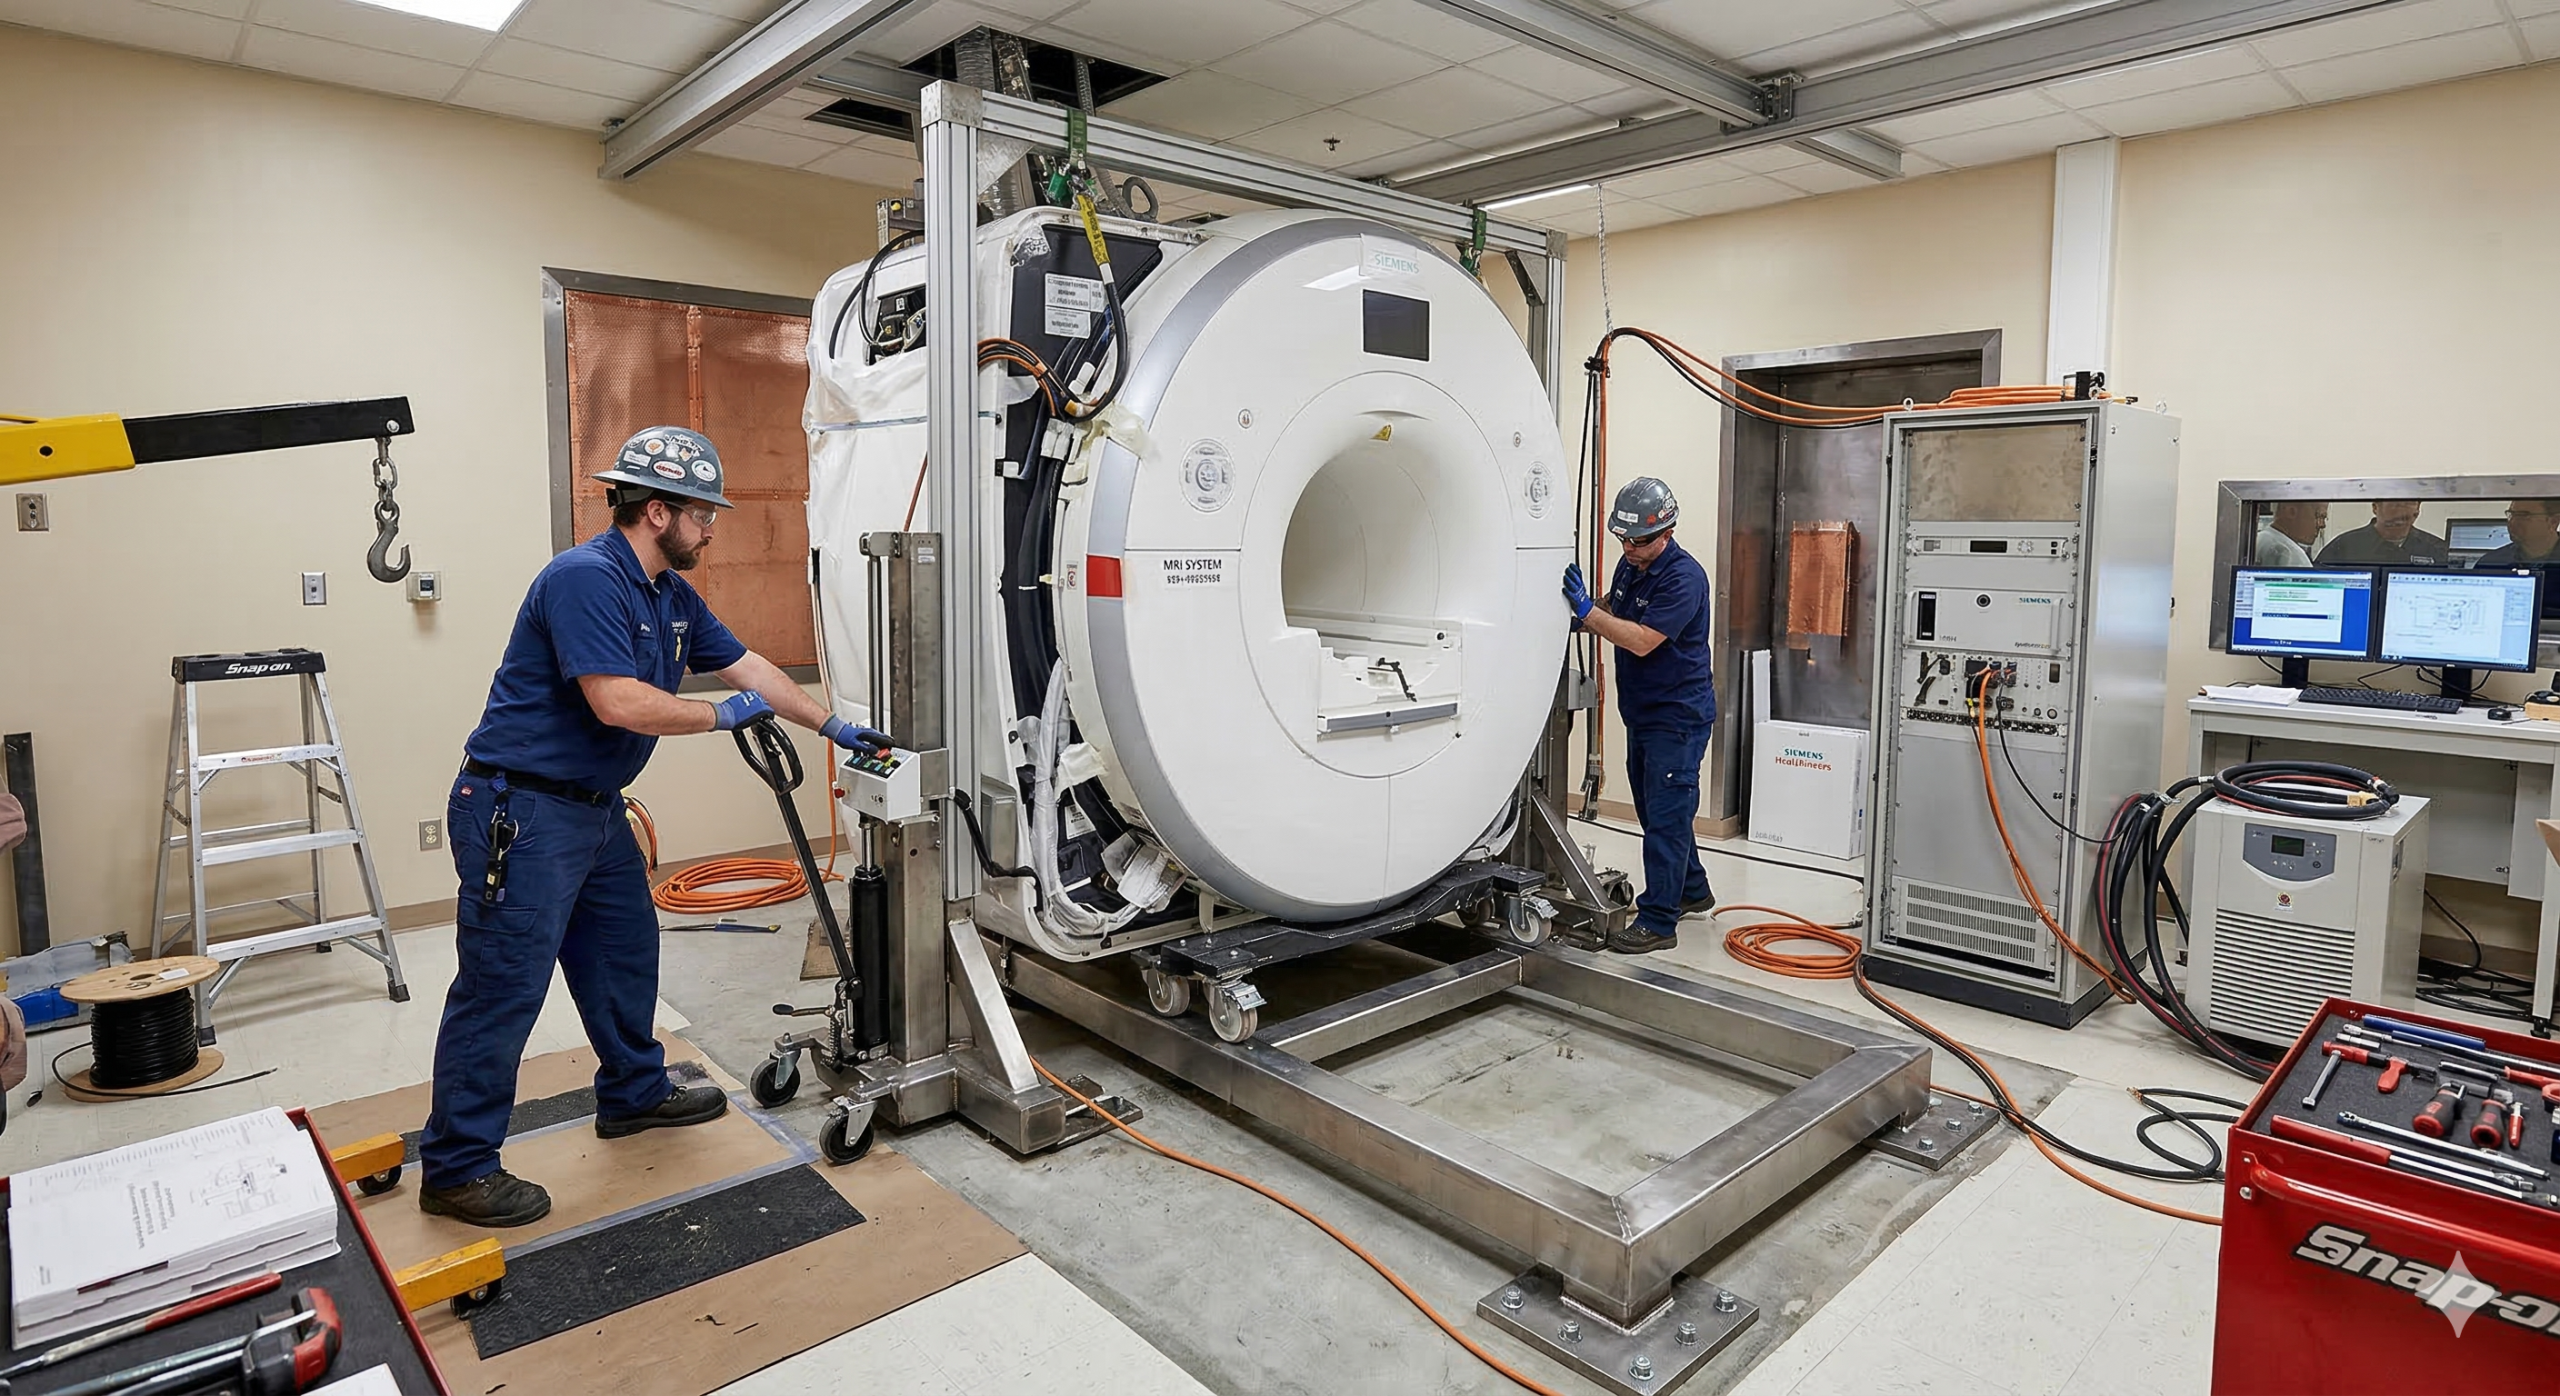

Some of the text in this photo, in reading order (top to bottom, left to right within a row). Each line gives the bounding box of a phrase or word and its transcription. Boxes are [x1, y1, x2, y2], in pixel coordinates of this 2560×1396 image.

[1374, 252, 1420, 274] SIEMENS
[1163, 558, 1222, 571] MRI SYSTEM
[225, 663, 269, 675] Snap
[1784, 748, 1824, 760] SIEMENS
[2295, 1223, 2560, 1337] Snap-o
